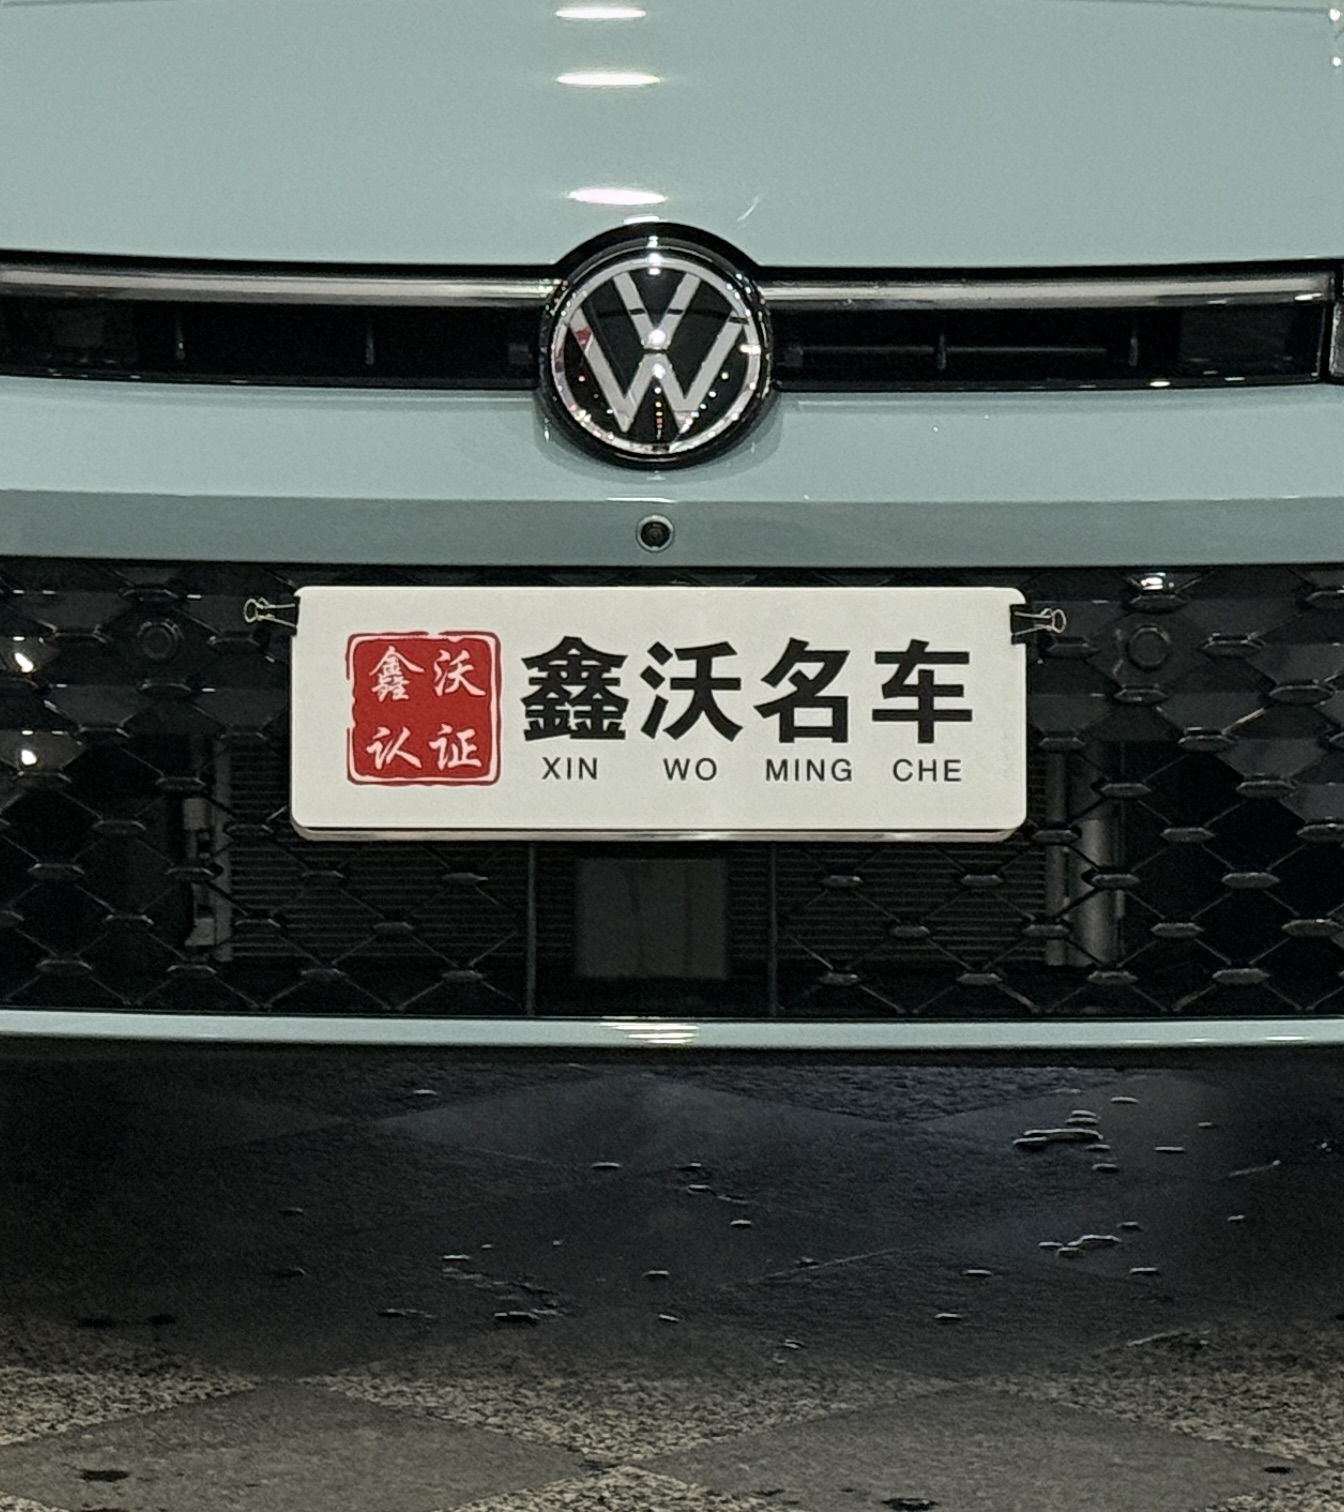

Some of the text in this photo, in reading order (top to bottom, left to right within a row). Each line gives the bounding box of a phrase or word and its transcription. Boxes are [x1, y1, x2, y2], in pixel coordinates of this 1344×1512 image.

[369, 645, 487, 703] 鑫沃
[520, 635, 974, 743] 鑫沃名车
[365, 723, 483, 771] 认证
[541, 757, 962, 782] XIN WO MING CHE
